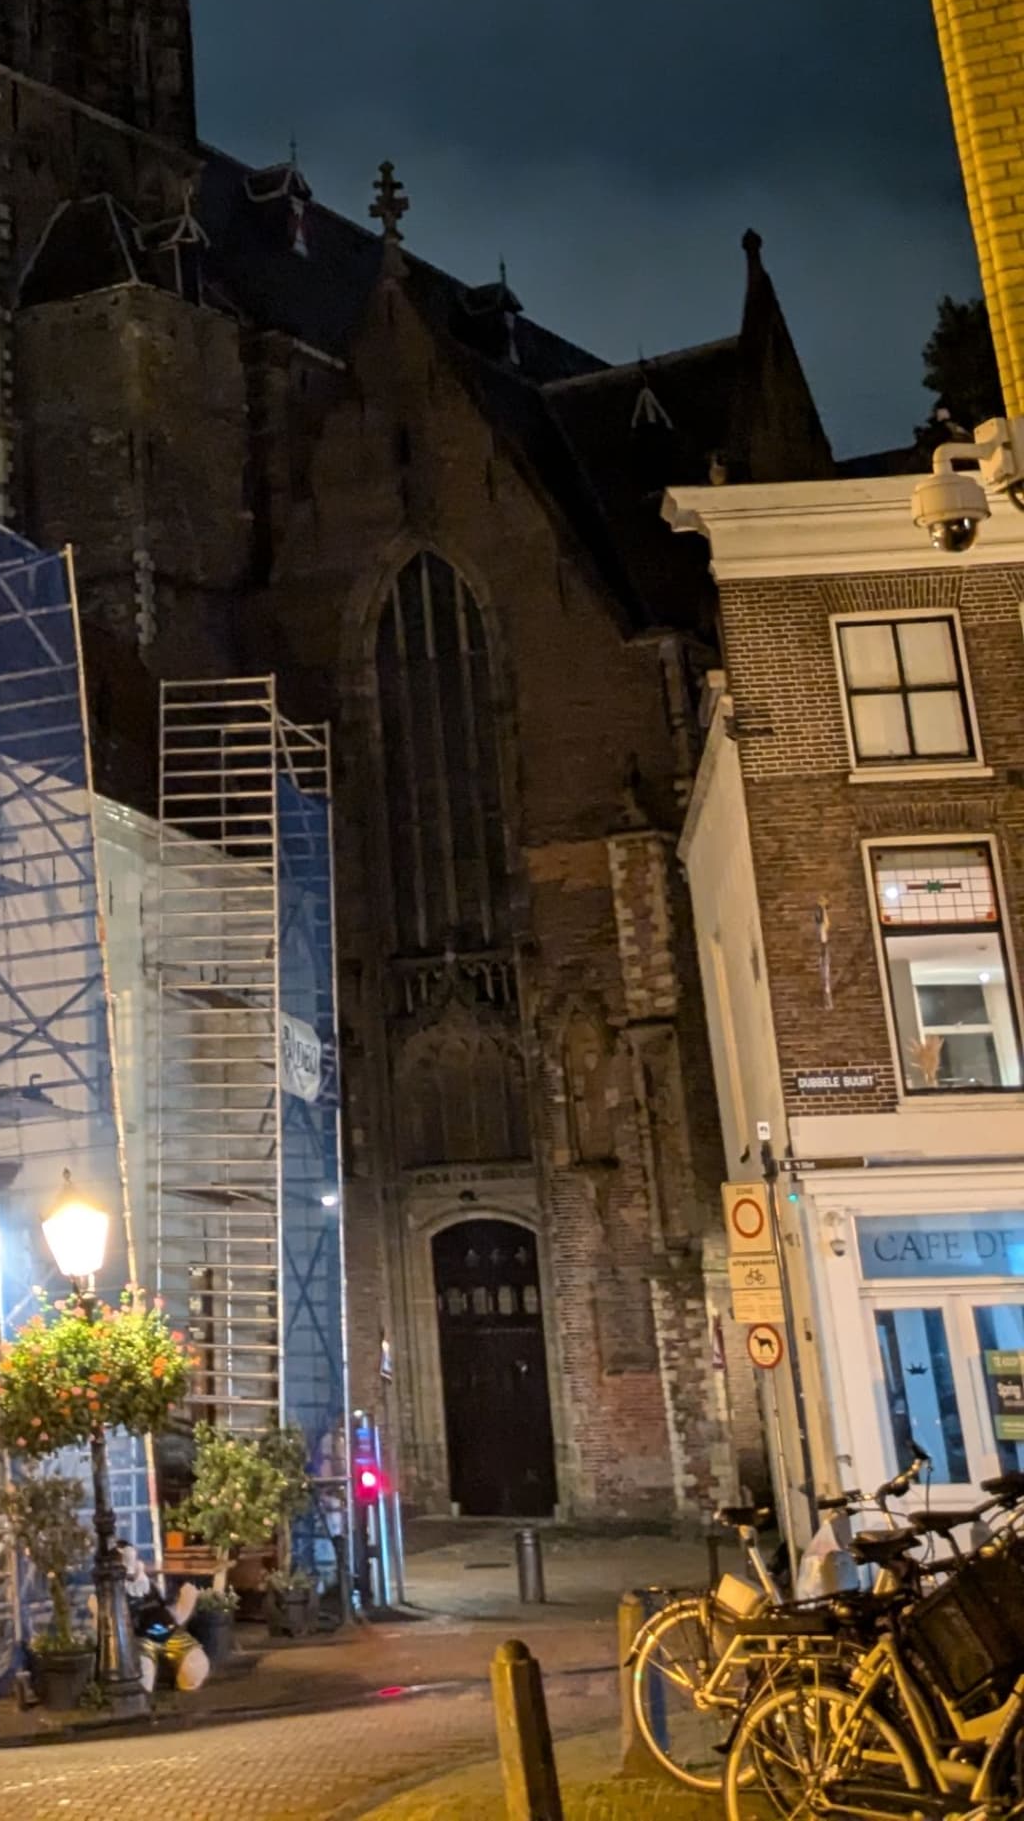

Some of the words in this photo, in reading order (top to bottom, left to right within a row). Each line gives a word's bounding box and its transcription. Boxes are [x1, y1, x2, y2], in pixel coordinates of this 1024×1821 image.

[797, 1076, 841, 1089] DUBBELE
[842, 1074, 874, 1087] BUURT
[873, 1230, 963, 1263] CAFE
